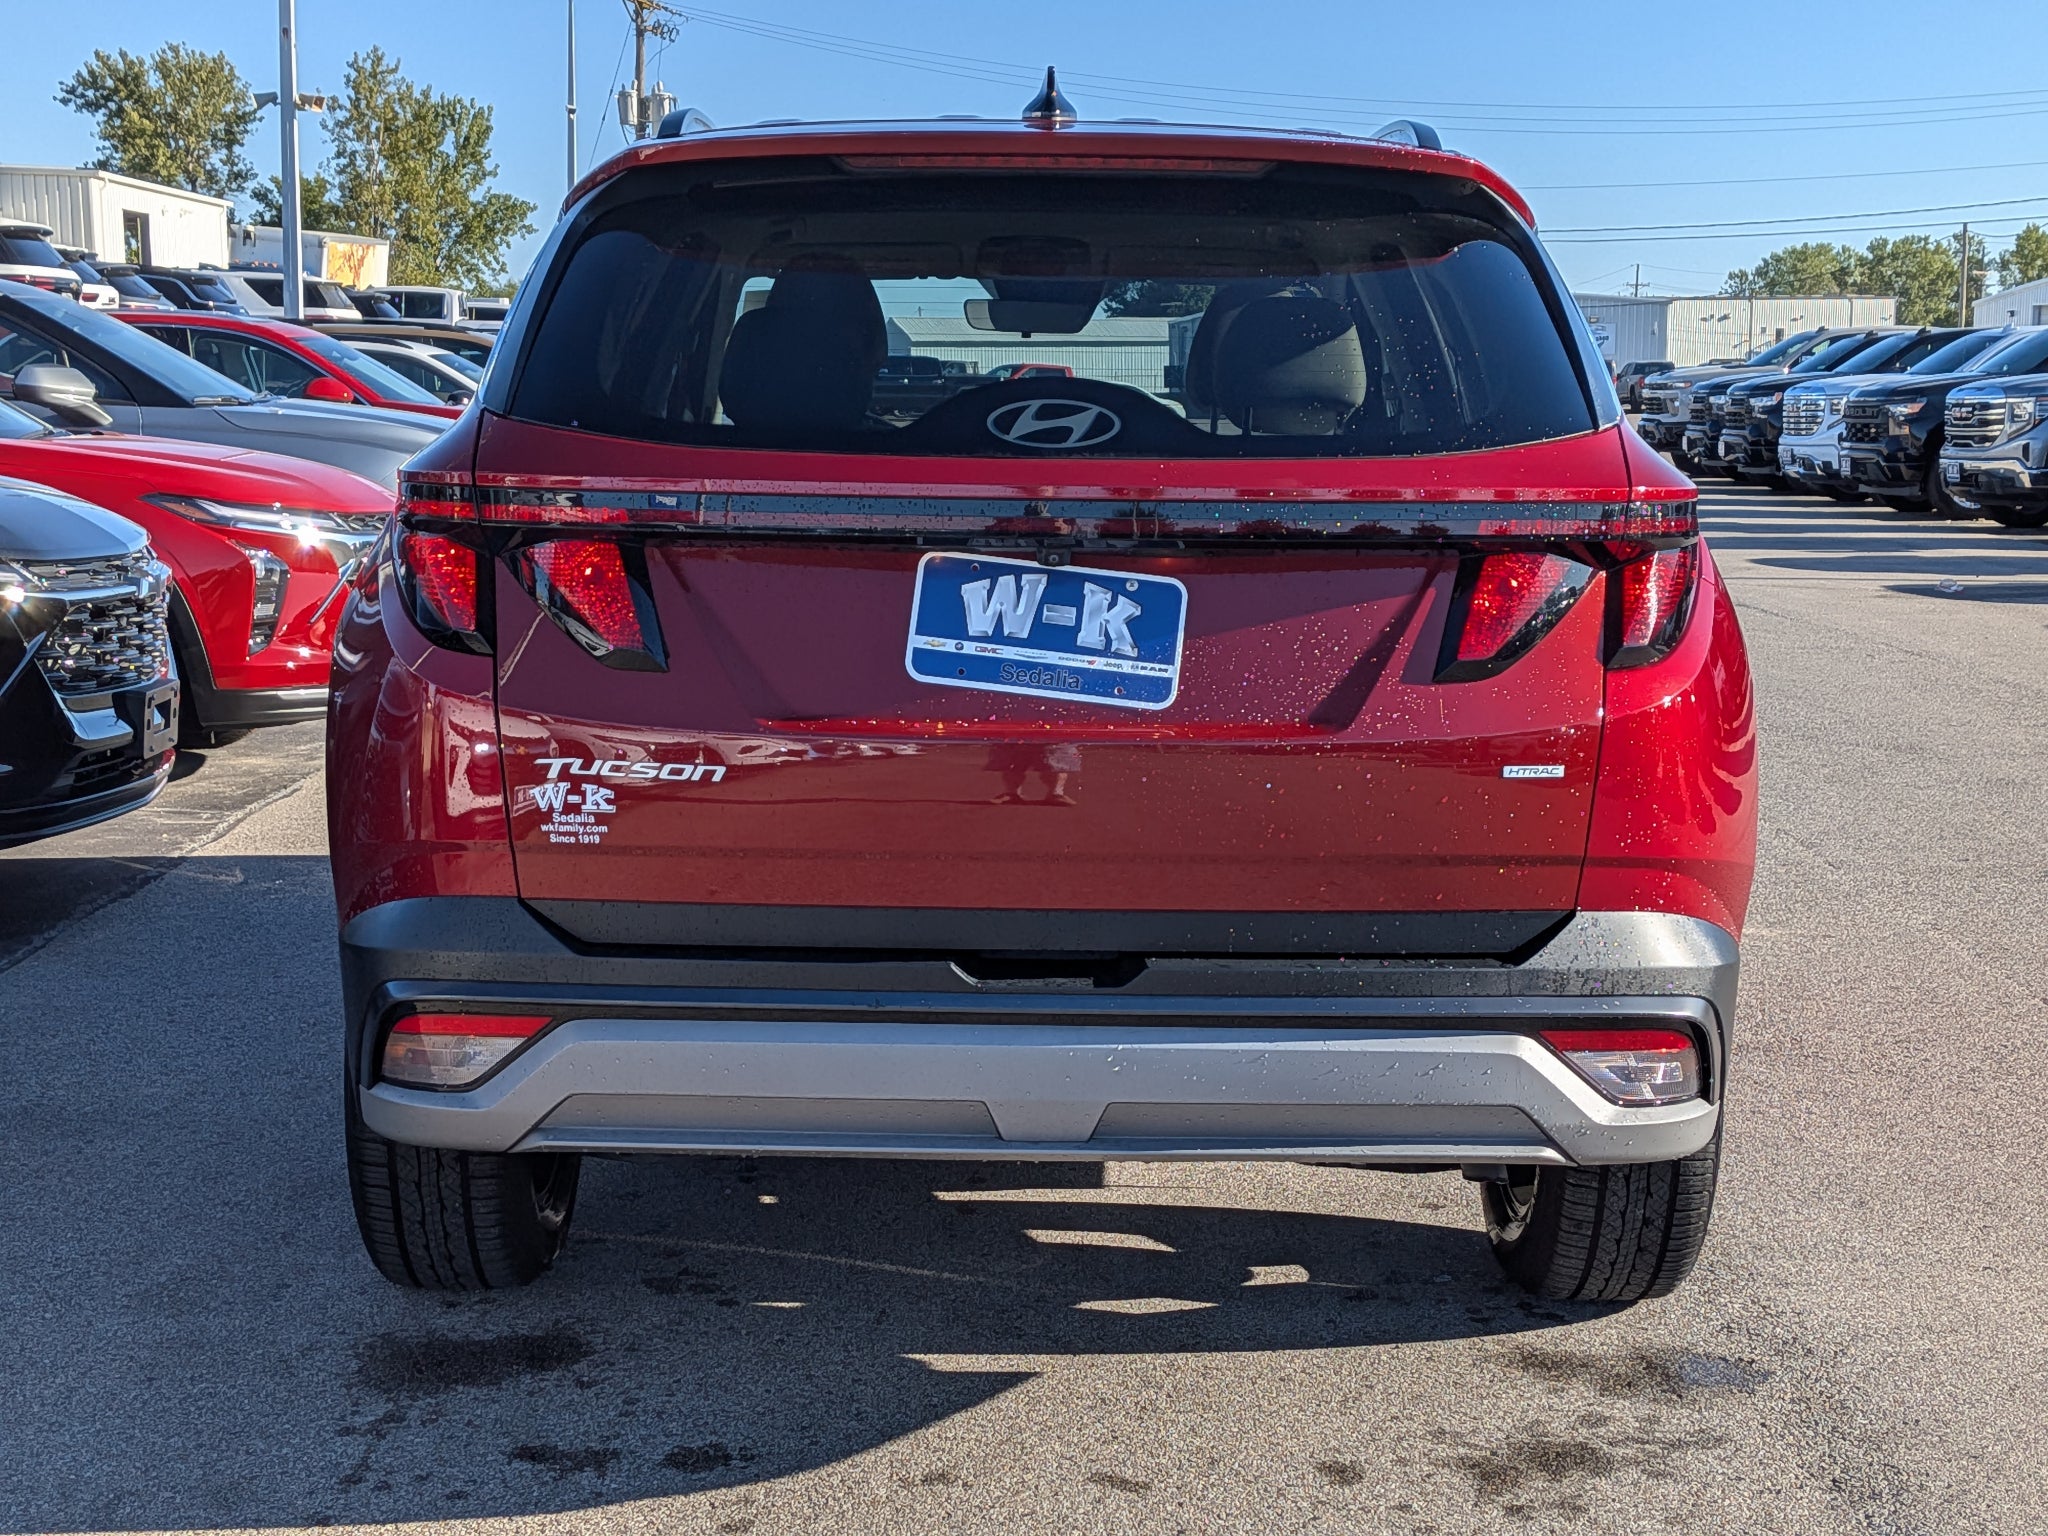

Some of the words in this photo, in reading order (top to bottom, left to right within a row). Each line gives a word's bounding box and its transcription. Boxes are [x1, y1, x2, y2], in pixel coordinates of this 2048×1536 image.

[961, 573, 1141, 657] W-K
[974, 645, 1004, 656] GMC
[1104, 660, 1121, 670] Jeep
[1000, 662, 1081, 691] Sedalia
[1507, 767, 1560, 776] HTRAC
[530, 782, 616, 813] W-K
[552, 812, 595, 823] Sedalia
[541, 823, 608, 834] wkfamily.com
[550, 833, 576, 843] Since
[578, 834, 600, 844] 1919
